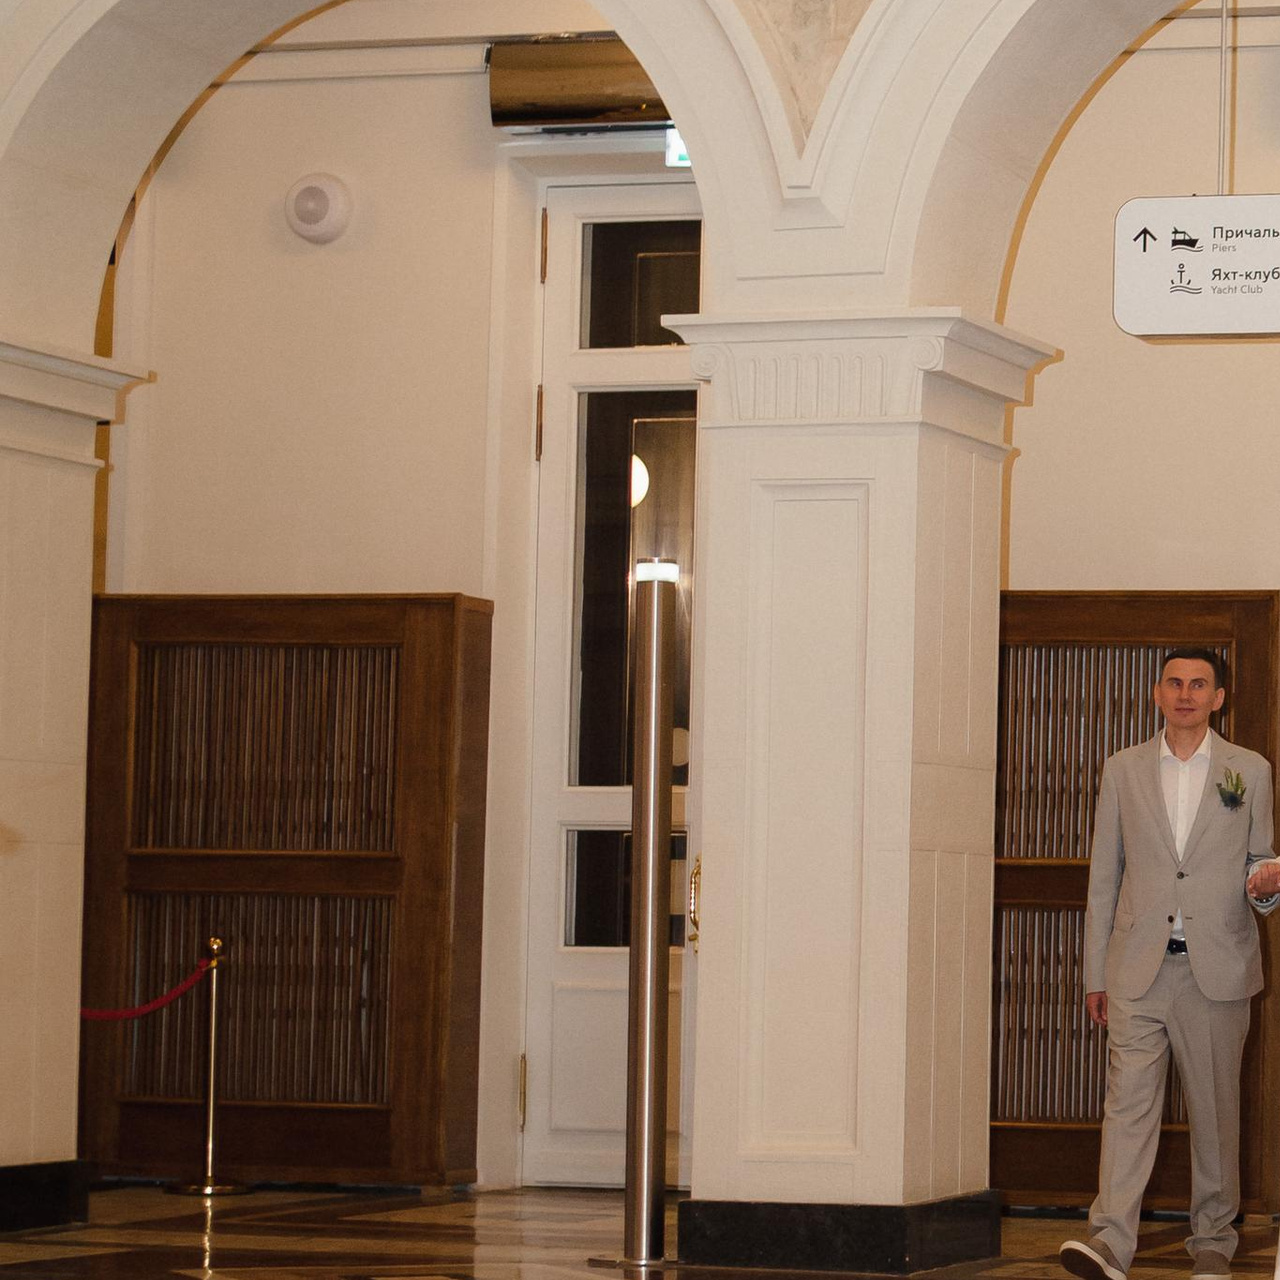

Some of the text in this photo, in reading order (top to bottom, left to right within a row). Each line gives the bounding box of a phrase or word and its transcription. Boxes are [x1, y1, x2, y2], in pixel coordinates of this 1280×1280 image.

[1212, 243, 1237, 252] Piers
[1211, 266, 1280, 283] Яхт-клуб
[1211, 284, 1263, 294] Yacht Club
